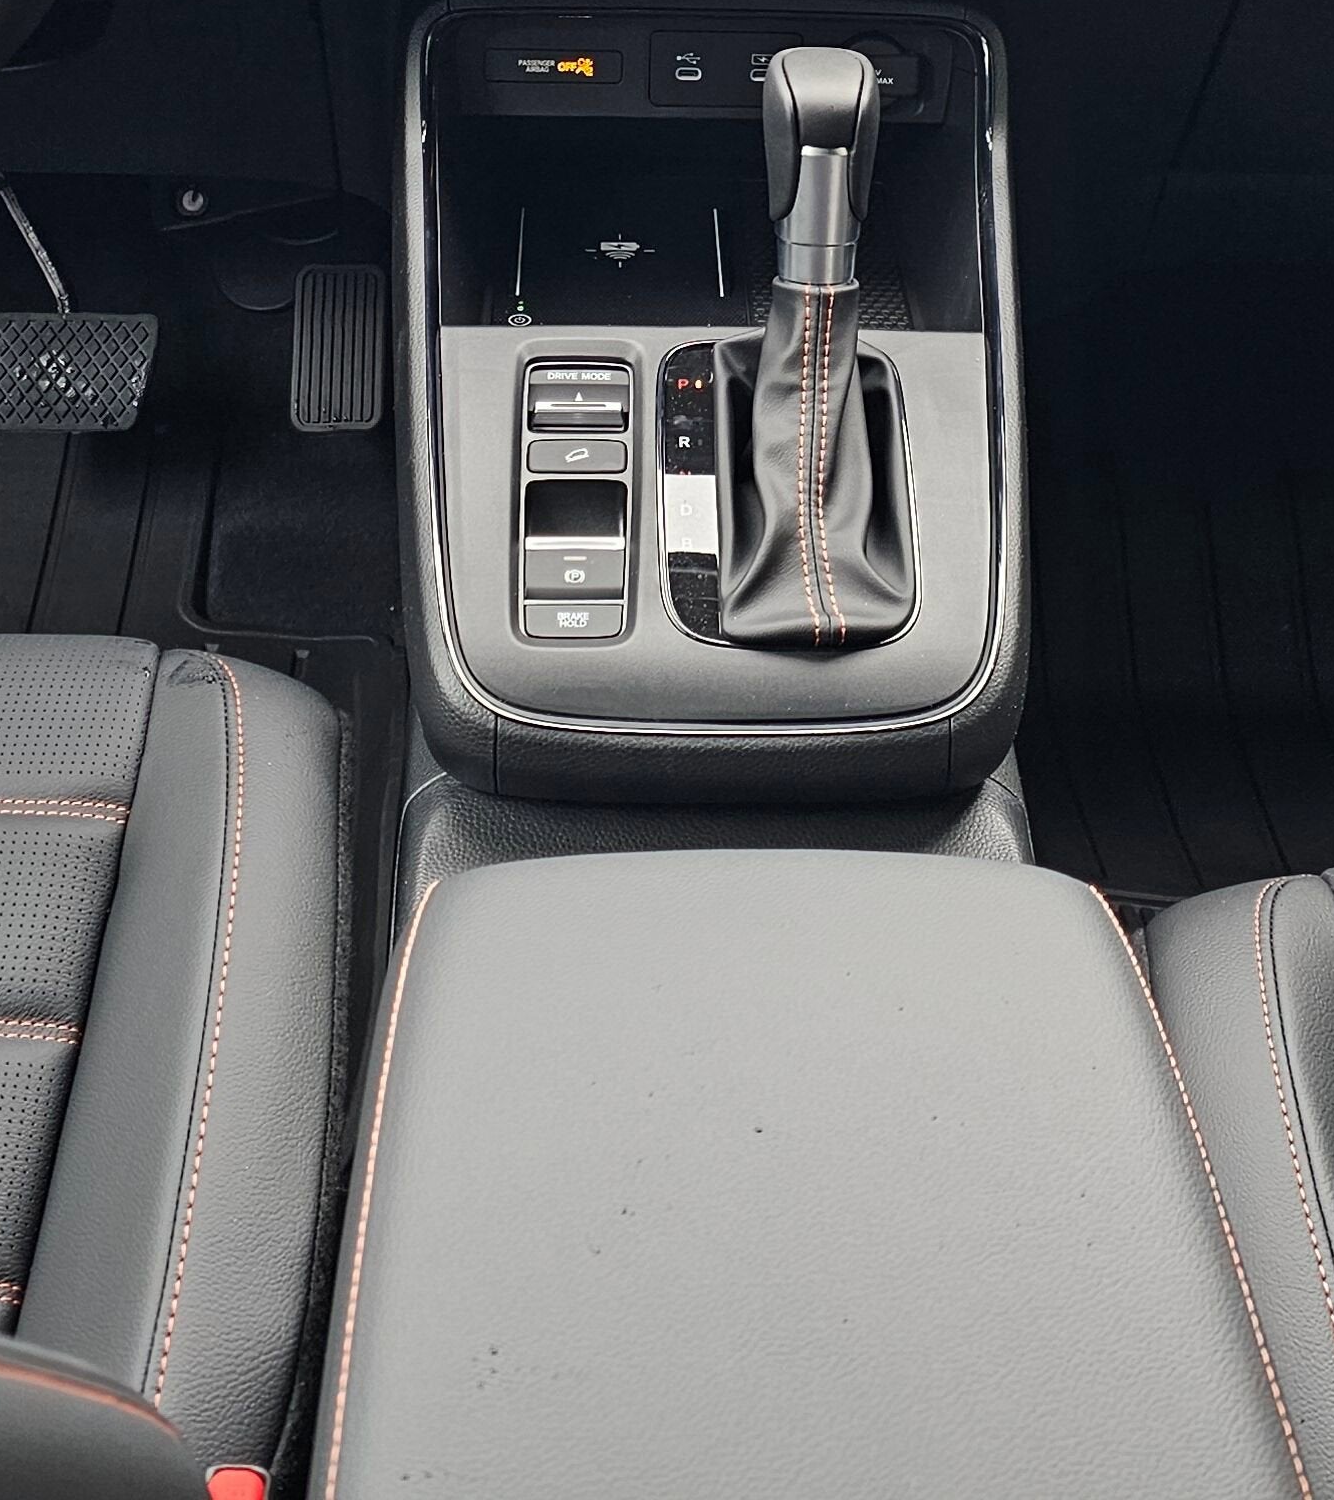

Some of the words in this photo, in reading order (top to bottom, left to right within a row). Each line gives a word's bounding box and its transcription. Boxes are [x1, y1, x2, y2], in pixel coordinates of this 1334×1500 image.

[517, 59, 556, 67] PASSENGER
[557, 61, 578, 73] OFF
[546, 371, 578, 382] DRIVE
[580, 371, 612, 382] MODE
[677, 378, 690, 390] P
[678, 435, 691, 448] R
[556, 611, 590, 621] BRAKE
[558, 619, 588, 628] HOLD
